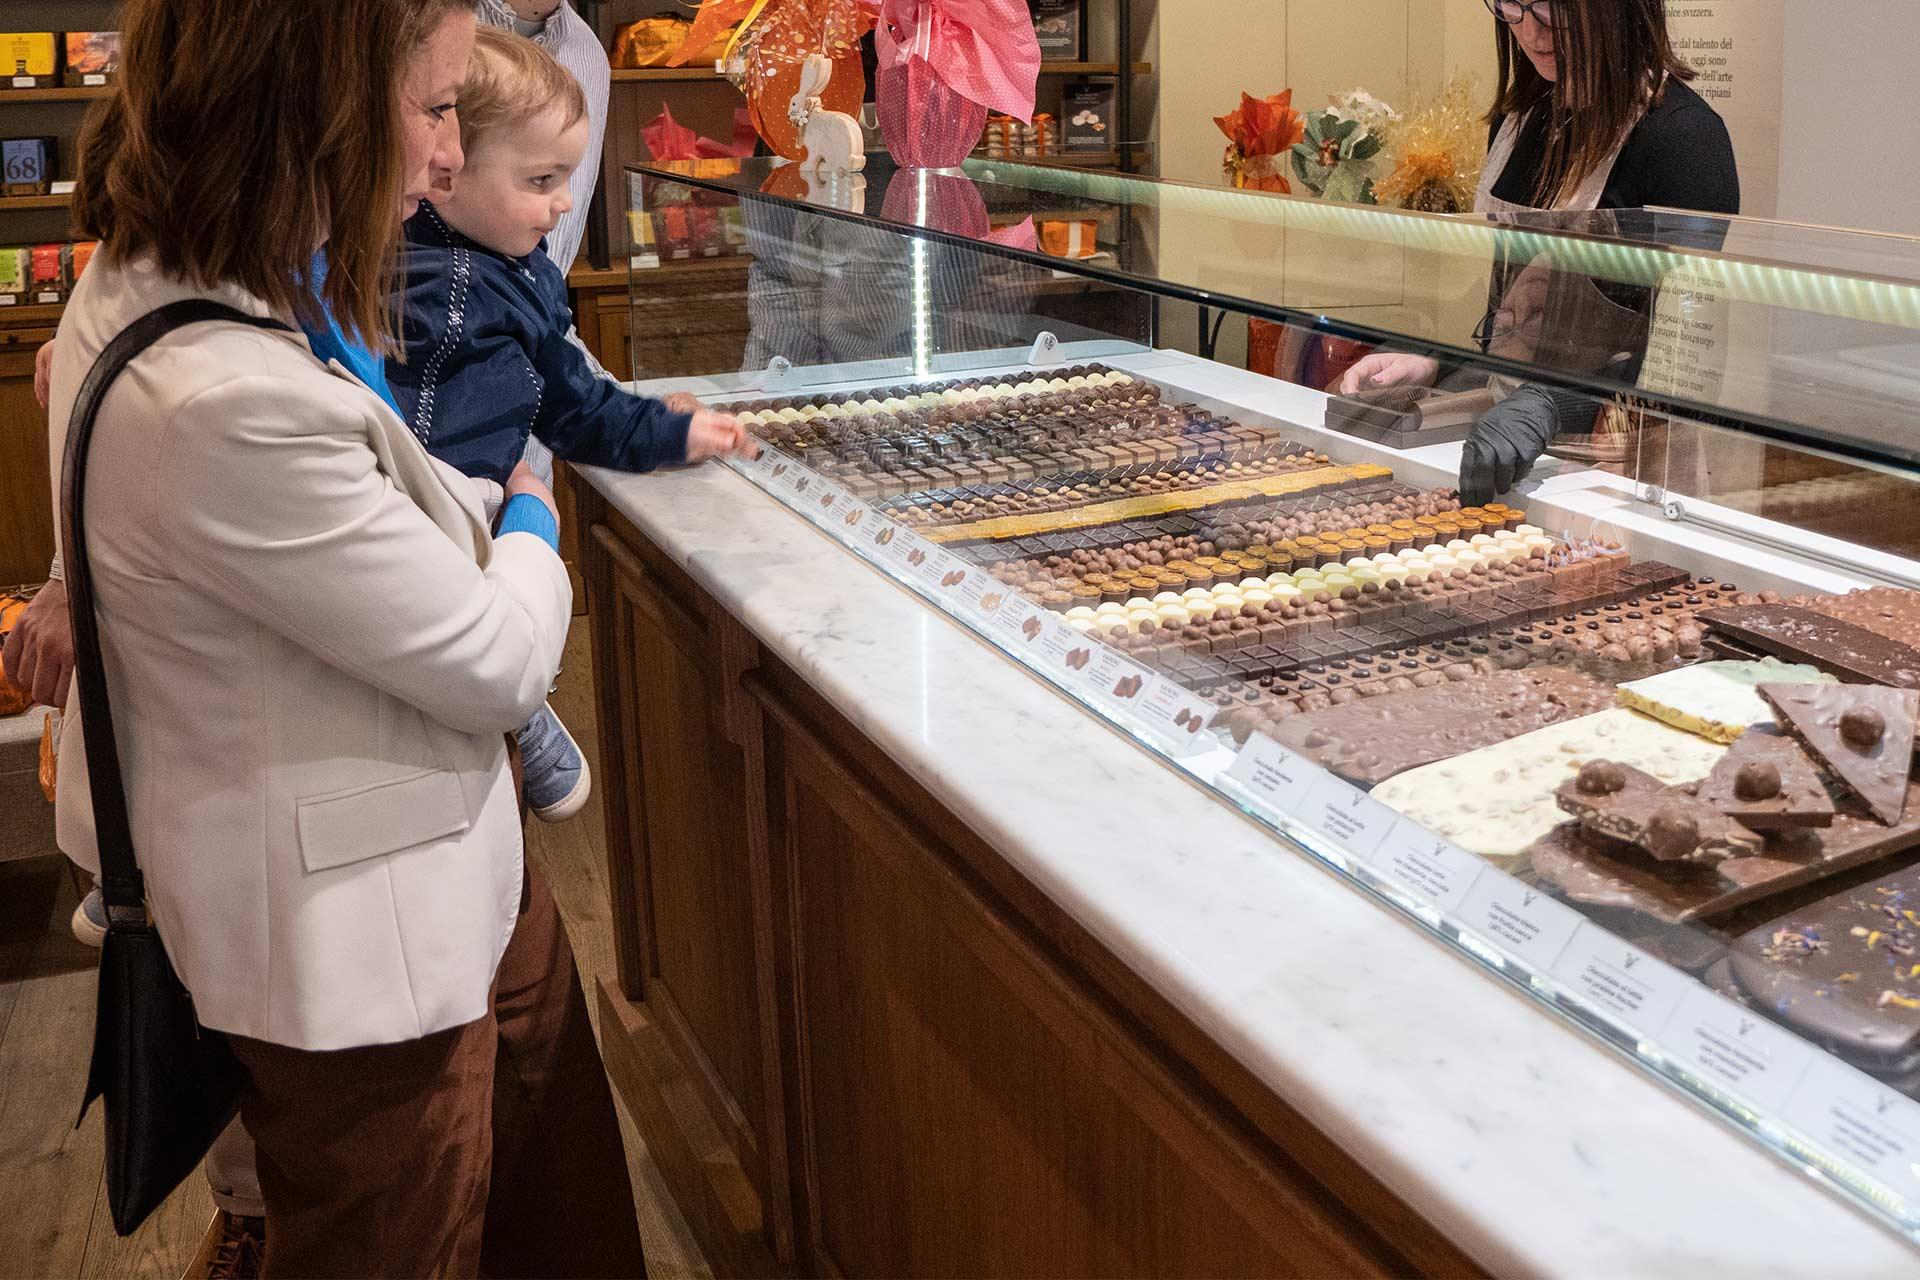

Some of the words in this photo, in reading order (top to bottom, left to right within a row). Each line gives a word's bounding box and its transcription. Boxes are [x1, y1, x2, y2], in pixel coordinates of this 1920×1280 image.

[1679, 38, 1691, 49] dal
[1692, 38, 1719, 49] talento
[1720, 38, 1733, 49] del
[1690, 54, 1707, 67] oggi
[1707, 57, 1727, 66] sono
[1705, 87, 1732, 100] ripiani
[7, 155, 38, 180] 68
